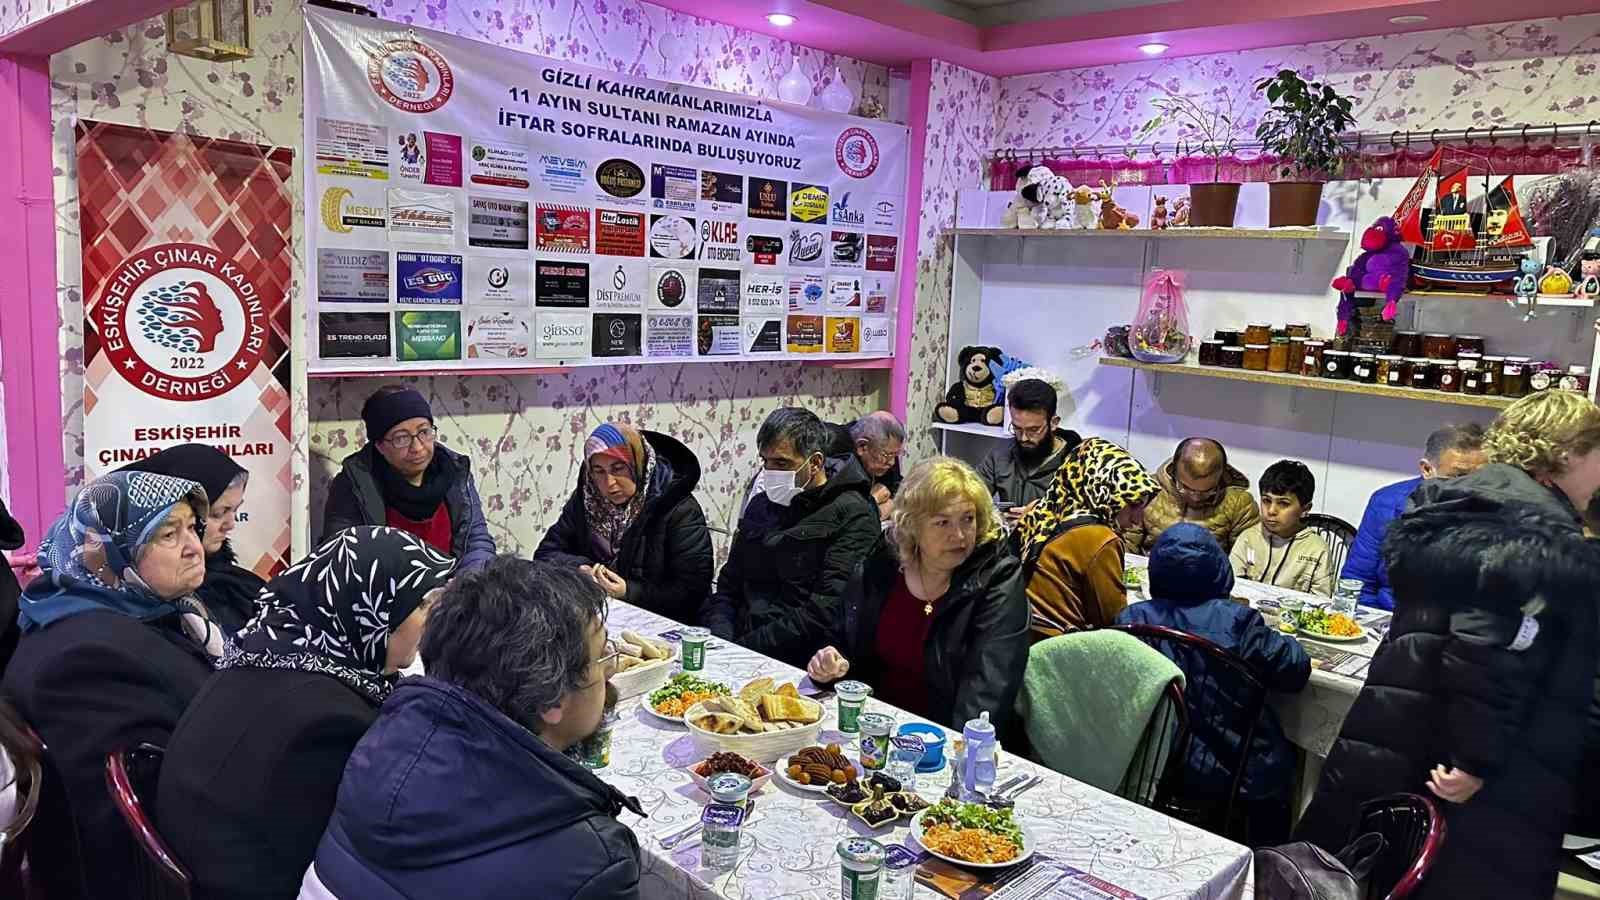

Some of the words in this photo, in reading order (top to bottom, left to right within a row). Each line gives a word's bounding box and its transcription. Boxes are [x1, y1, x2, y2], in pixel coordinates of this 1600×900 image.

[541, 68, 591, 90] GİZLİ
[596, 80, 773, 123] KAHRAMANLARIMIZLA
[508, 87, 530, 104] 11
[537, 93, 582, 113] AYIN
[588, 101, 660, 126] SULTANI
[666, 116, 740, 140] RAMAZAN
[744, 127, 795, 148] AYINDA
[498, 107, 556, 133] İFTAR
[561, 121, 692, 154] SOFRALARINDA
[697, 143, 802, 171] BULUŞUYORUZ
[345, 205, 384, 217] MESUT
[711, 220, 737, 244] KLAS
[103, 256, 153, 353] ESKİŞEHİR
[153, 248, 217, 269] ÇINAR
[219, 264, 265, 356] KADINLARI
[169, 356, 206, 371] 2022
[140, 366, 232, 397] DERNEĞİ
[134, 423, 242, 444] ESKİŞEHİR
